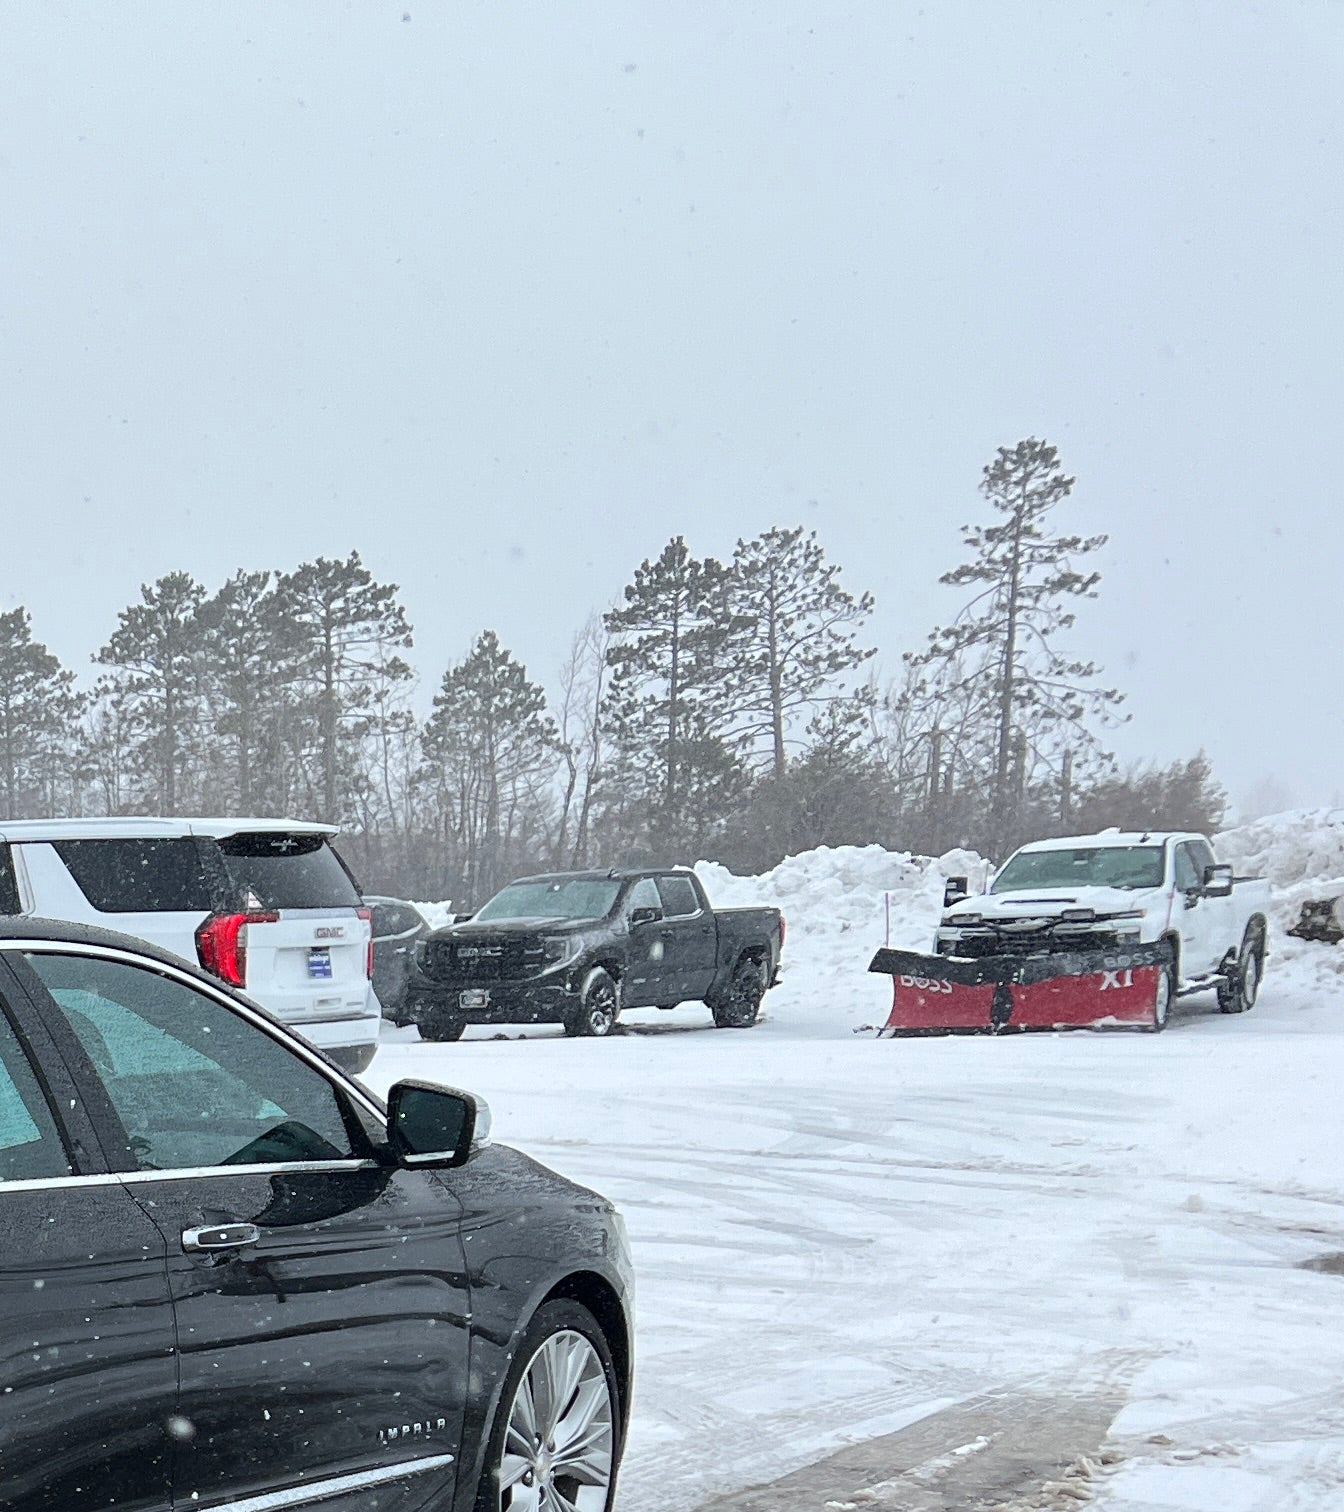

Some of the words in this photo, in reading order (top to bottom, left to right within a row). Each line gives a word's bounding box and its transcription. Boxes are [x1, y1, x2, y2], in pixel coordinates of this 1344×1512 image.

[314, 926, 344, 939] GMC
[1103, 951, 1155, 968] BOSS
[378, 1418, 446, 1441] IMPALA
